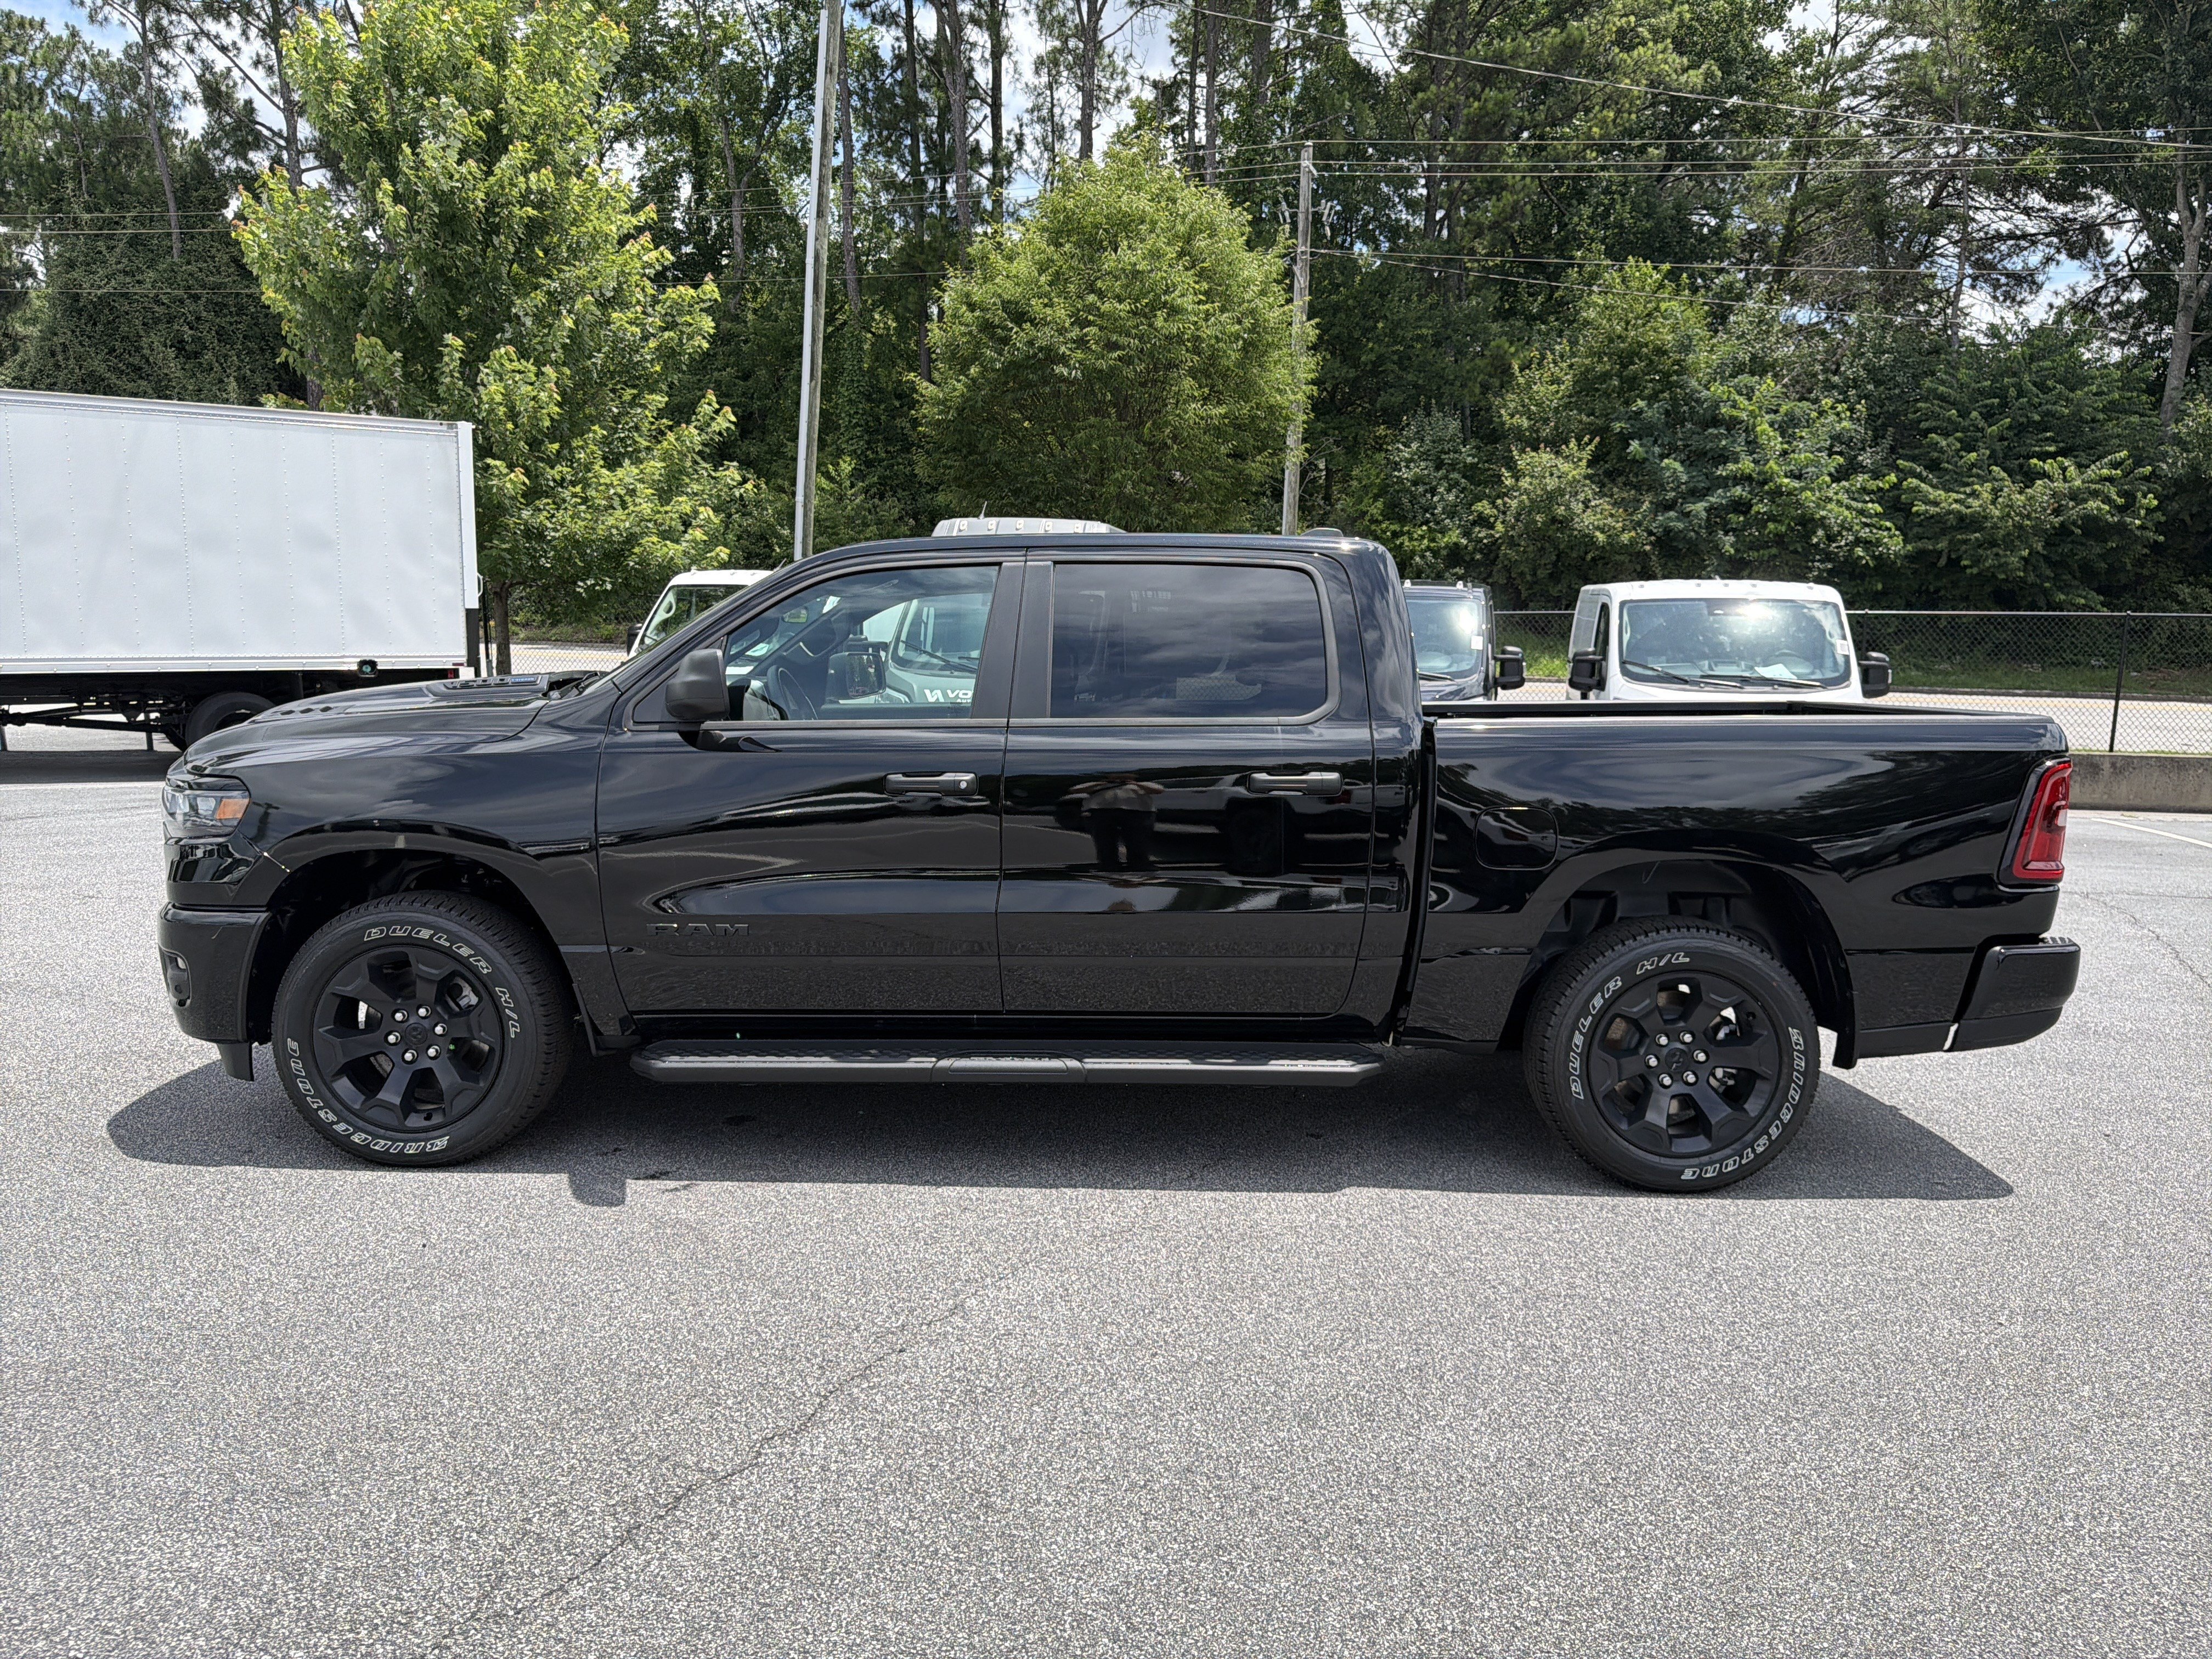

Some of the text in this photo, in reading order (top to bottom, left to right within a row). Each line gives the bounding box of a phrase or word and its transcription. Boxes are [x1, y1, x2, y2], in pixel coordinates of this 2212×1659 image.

[946, 689, 974, 698] VO
[364, 926, 520, 1038] DUELER H/L
[646, 923, 749, 936] RAM
[1569, 952, 1690, 1099] DUELER H/L
[287, 1037, 449, 1153] BRIDGESTONE
[1680, 1026, 1805, 1180] BRIDGESTONE
